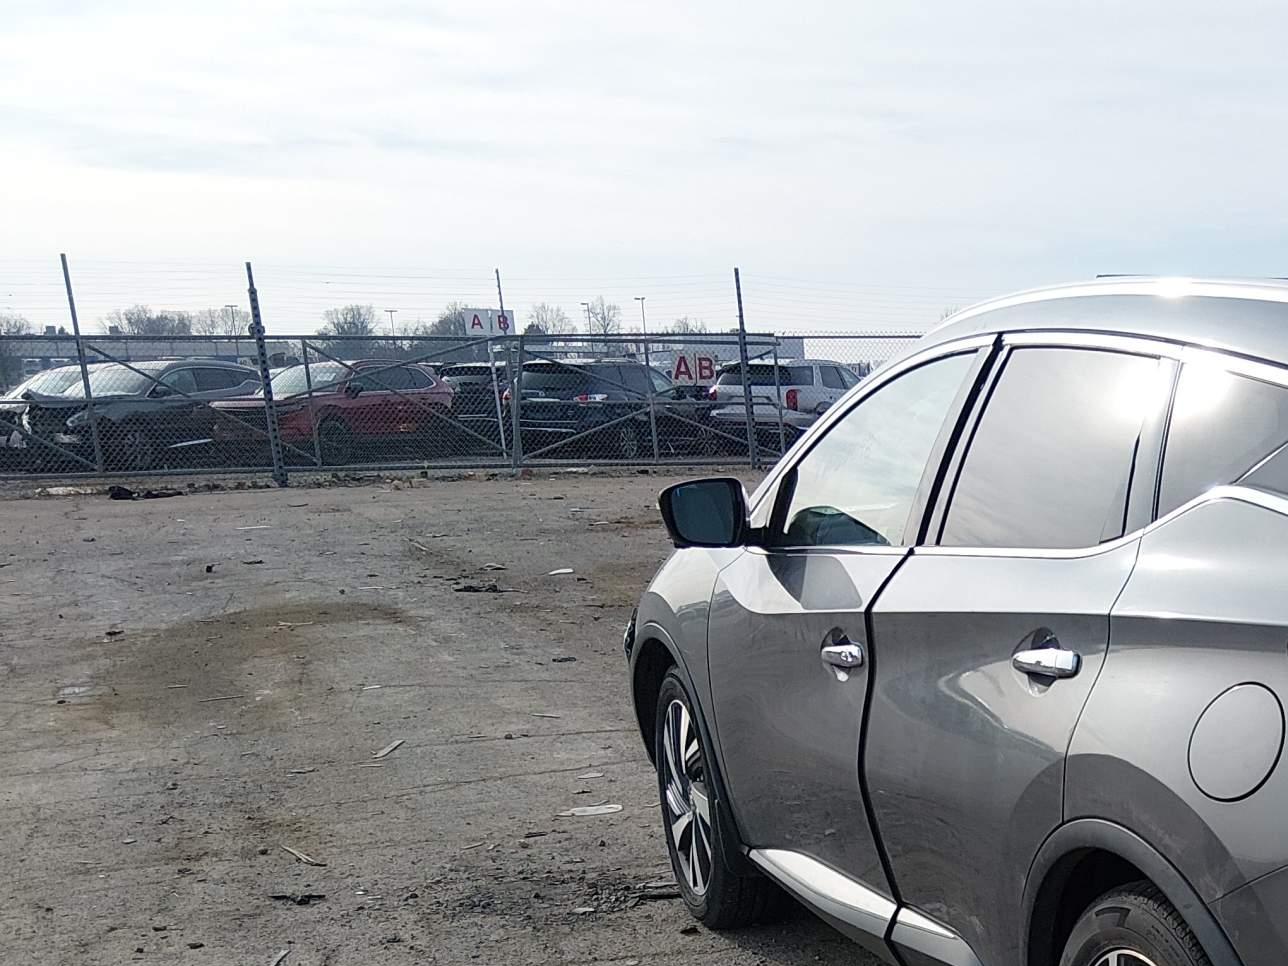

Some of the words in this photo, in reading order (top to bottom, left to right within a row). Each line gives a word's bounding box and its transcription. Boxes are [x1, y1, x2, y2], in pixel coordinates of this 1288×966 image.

[471, 313, 484, 329] A
[674, 356, 693, 380] A
[697, 357, 714, 379] B
